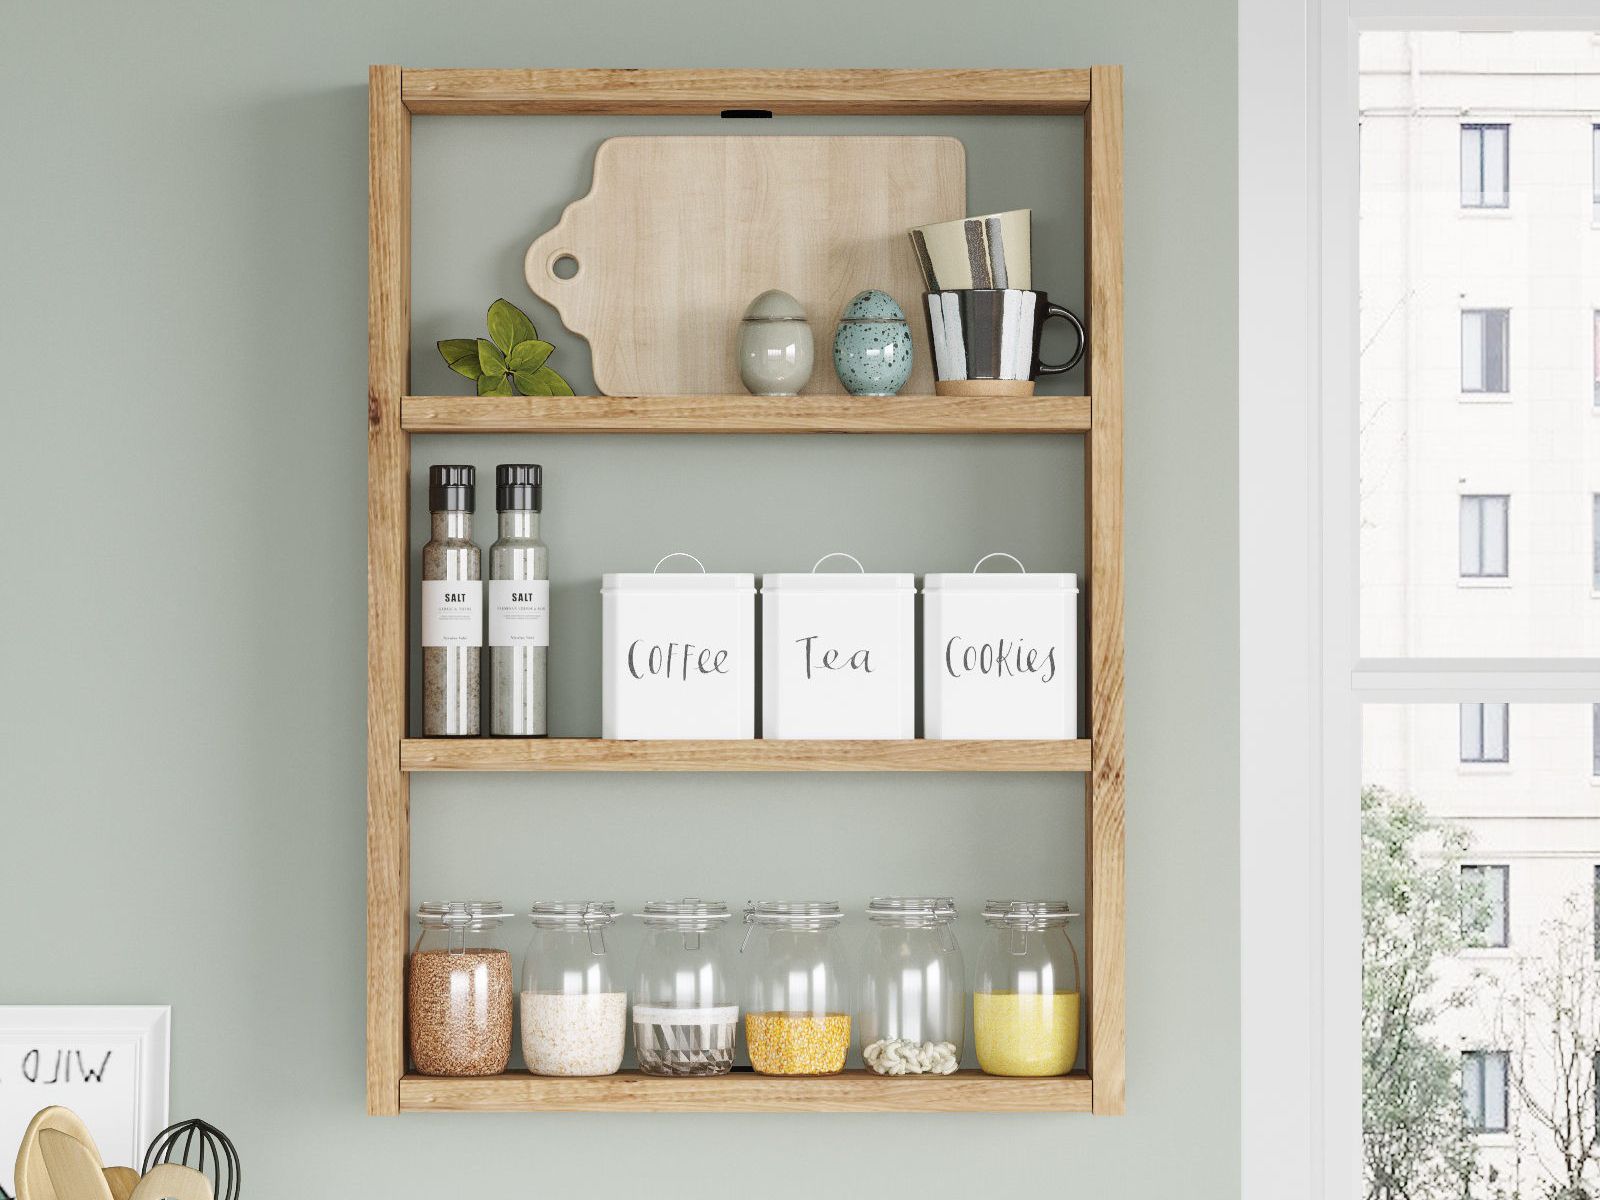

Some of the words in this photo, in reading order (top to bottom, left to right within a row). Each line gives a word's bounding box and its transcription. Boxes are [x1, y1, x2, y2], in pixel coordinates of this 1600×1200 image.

[444, 593, 466, 603] SALT
[511, 592, 533, 602] SALT
[795, 635, 874, 680] Tea
[945, 635, 1056, 684] Cookies
